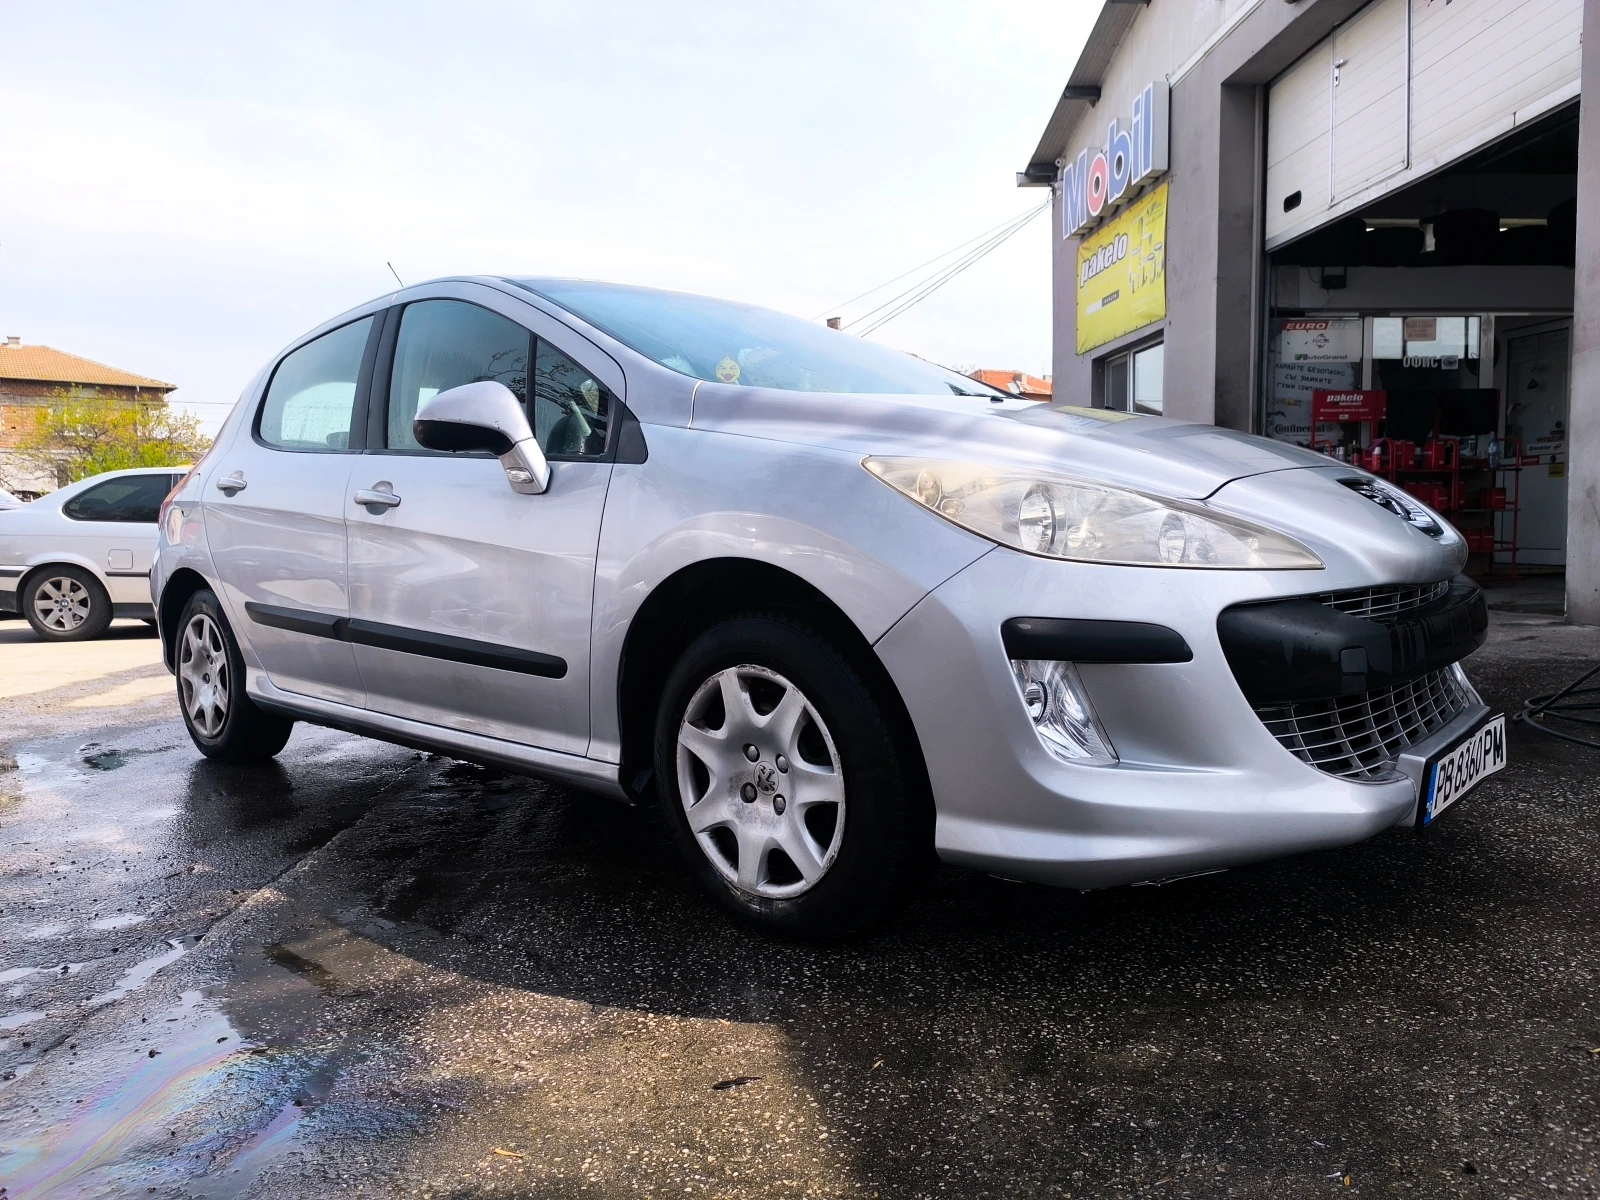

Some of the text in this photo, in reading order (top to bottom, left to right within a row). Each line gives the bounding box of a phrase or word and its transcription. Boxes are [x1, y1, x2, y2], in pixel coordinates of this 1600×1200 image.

[1062, 81, 1154, 241] Mobil
[1079, 231, 1129, 289] pakelo
[1402, 355, 1439, 369] ОФИС
[1326, 393, 1364, 402] pakelo
[1274, 424, 1326, 434] Continenal
